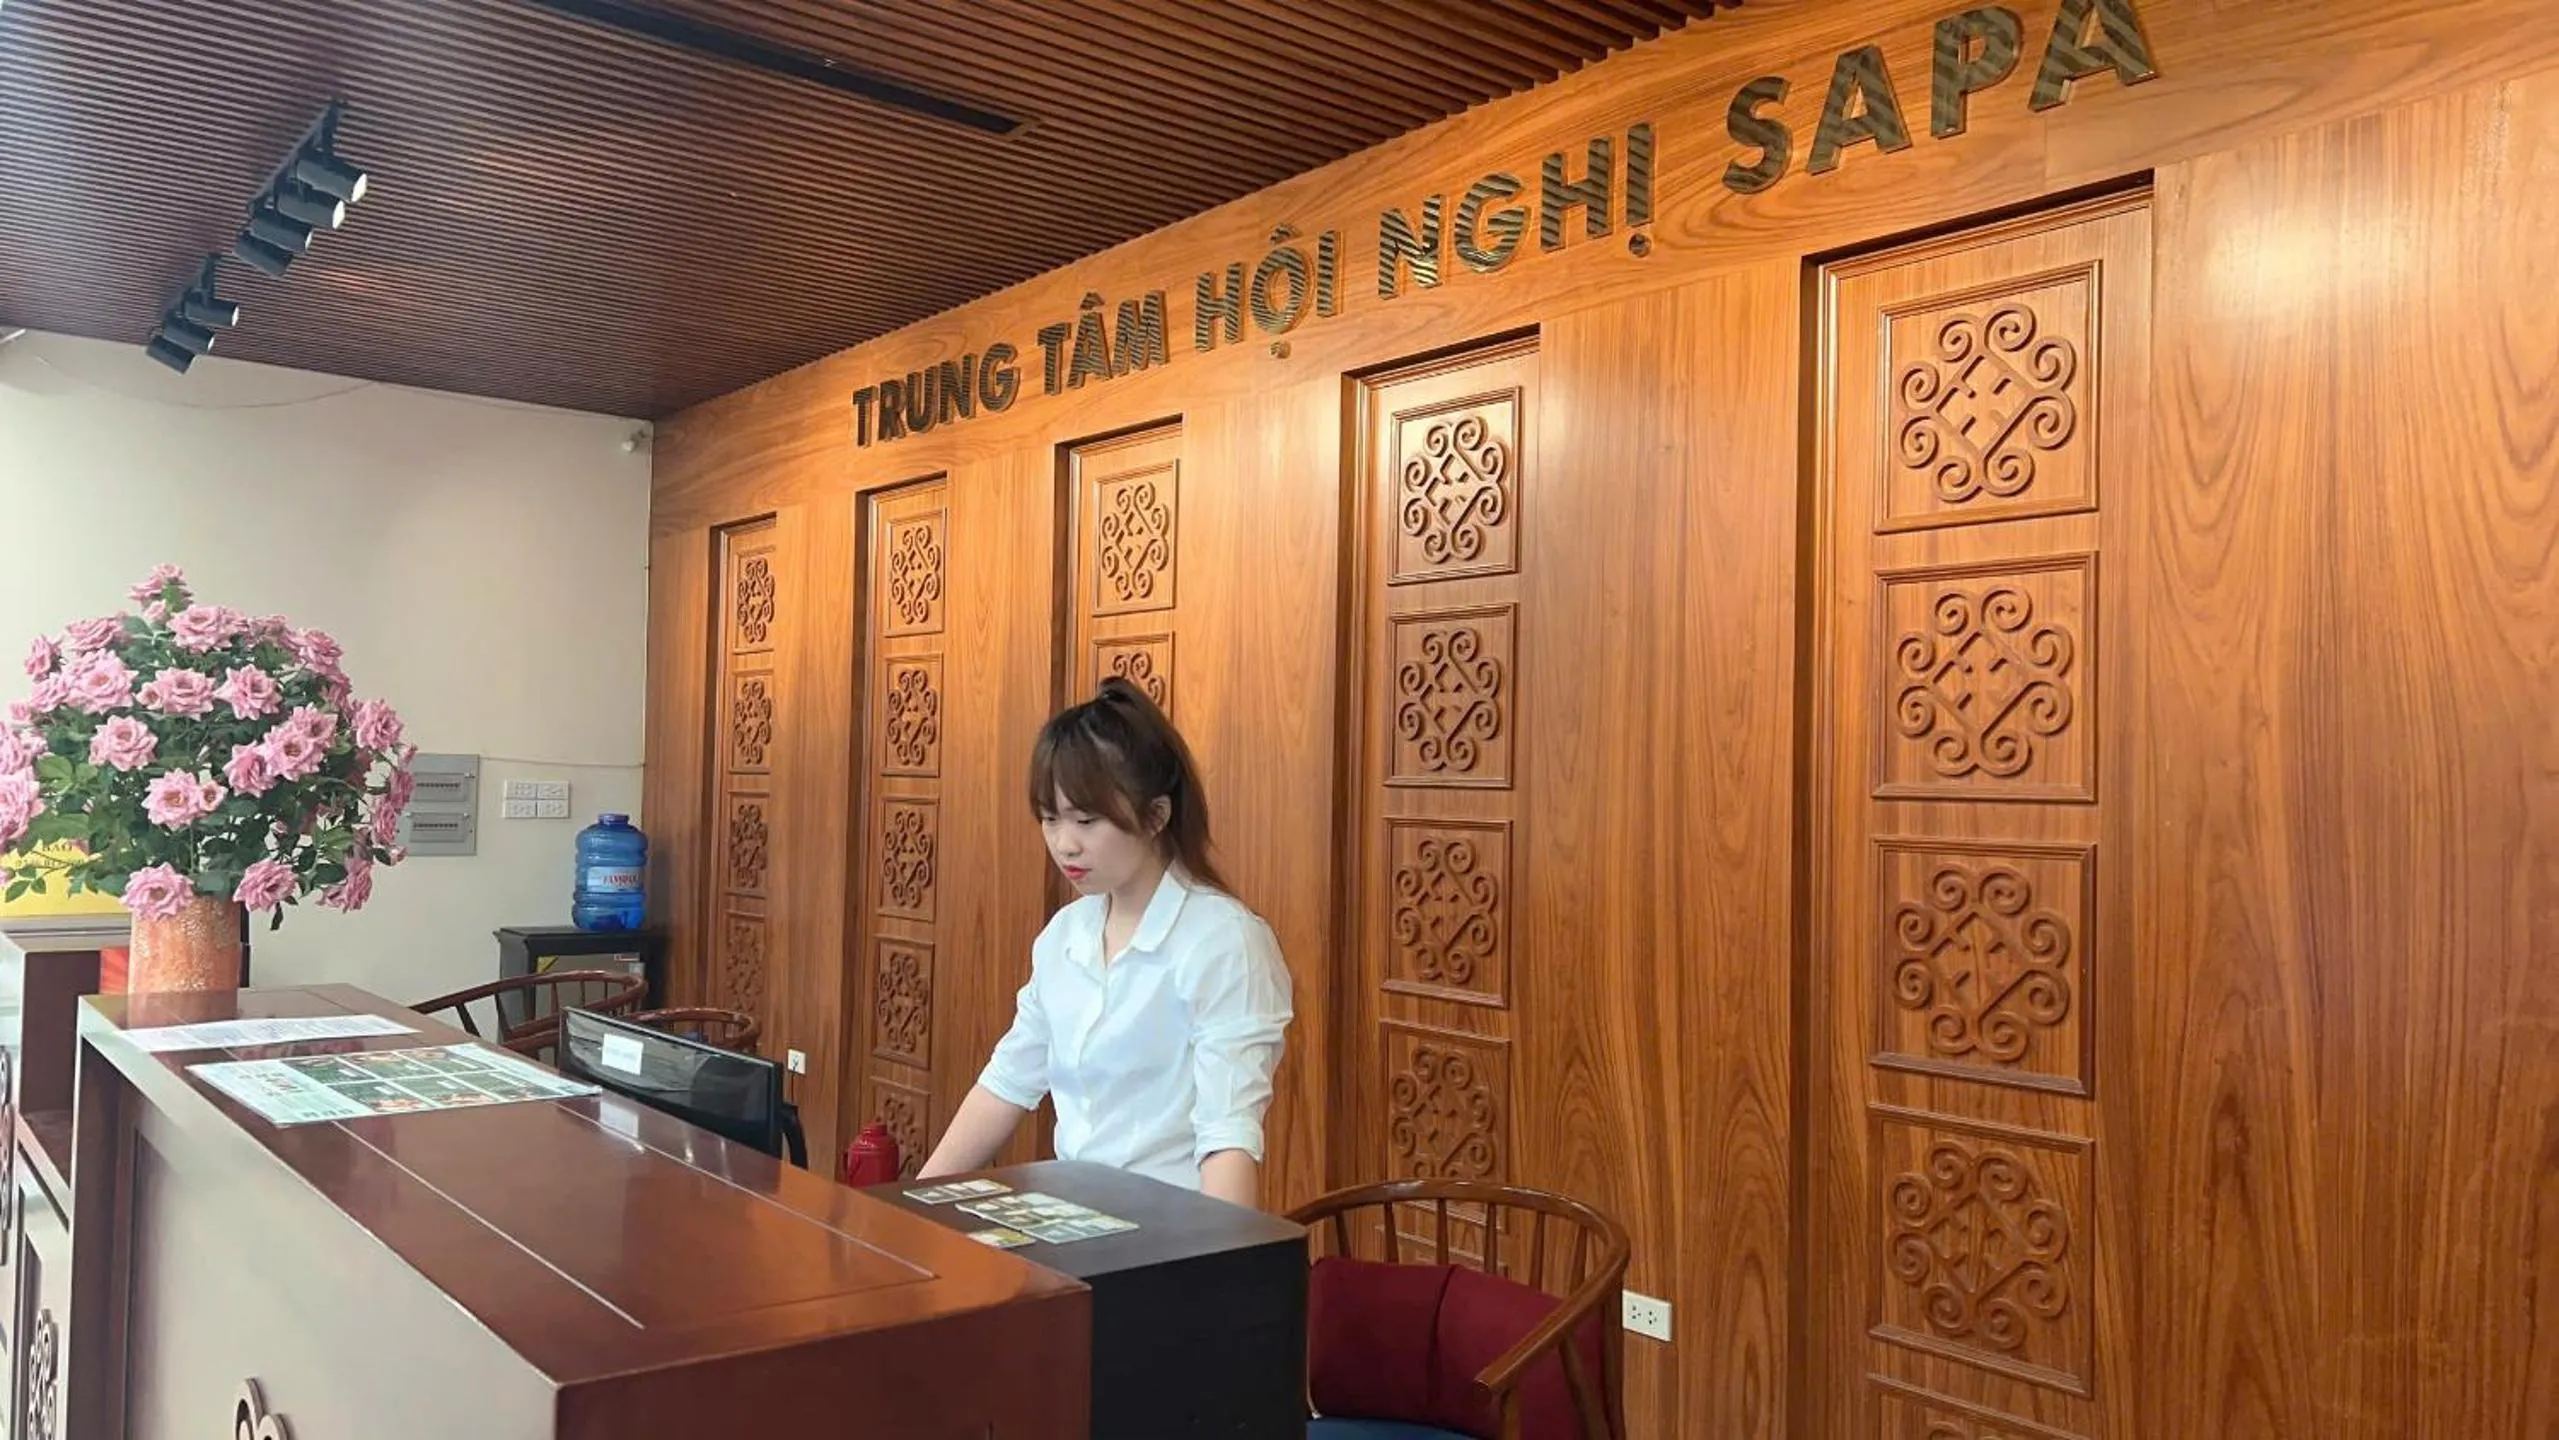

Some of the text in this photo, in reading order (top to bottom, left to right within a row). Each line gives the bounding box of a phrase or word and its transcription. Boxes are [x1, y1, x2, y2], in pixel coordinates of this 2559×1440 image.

[852, 0, 2160, 448] TRUNG TÂM HỘI NGHỊ SAPA
